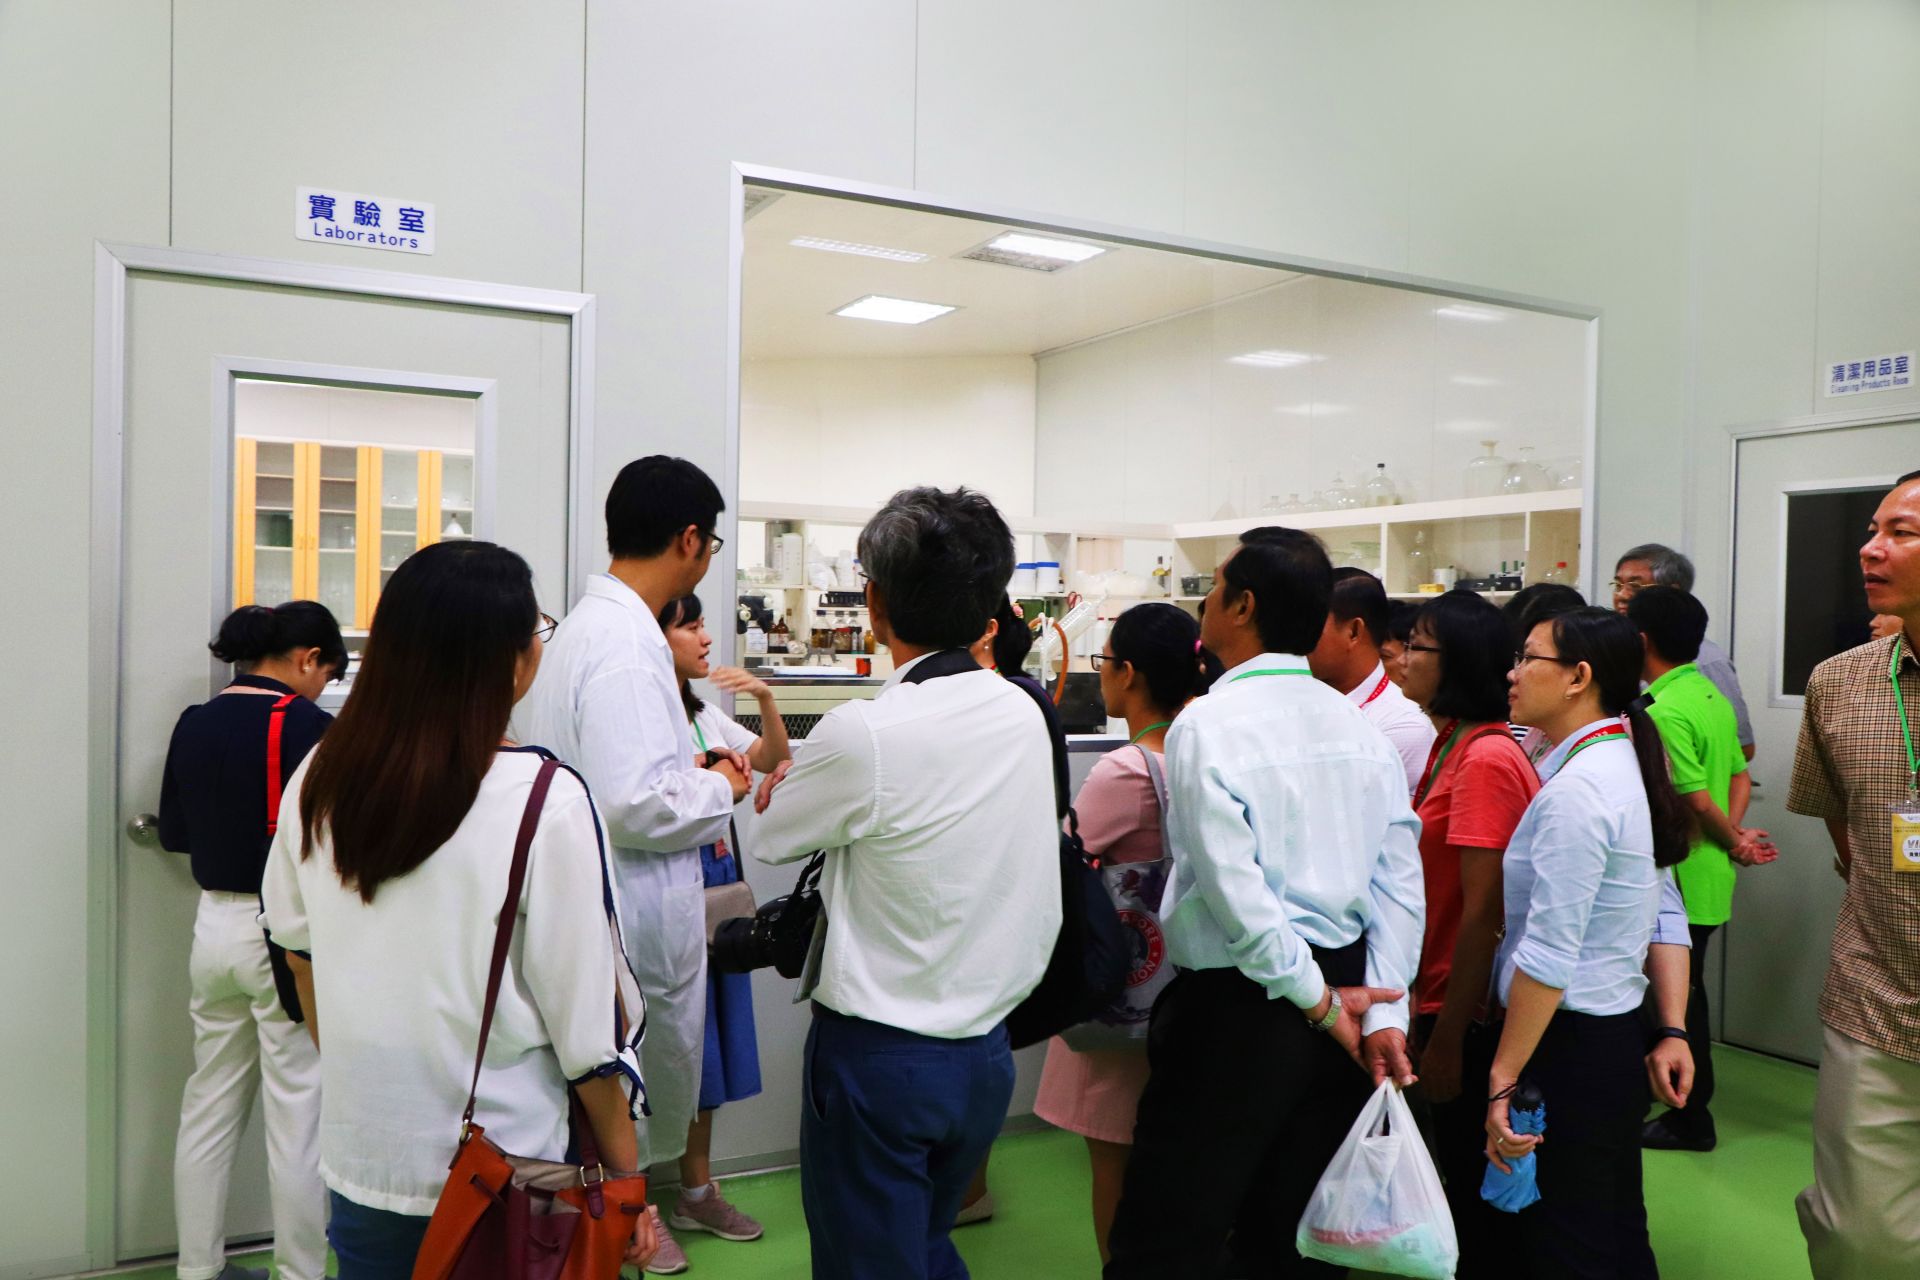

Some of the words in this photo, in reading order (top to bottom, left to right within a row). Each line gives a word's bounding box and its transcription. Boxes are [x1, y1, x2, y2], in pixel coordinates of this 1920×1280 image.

[308, 194, 425, 233] 實驗室
[313, 222, 419, 249] Laborators
[1831, 356, 1909, 383] 清潔用品室
[1908, 839, 1920, 849] VI
